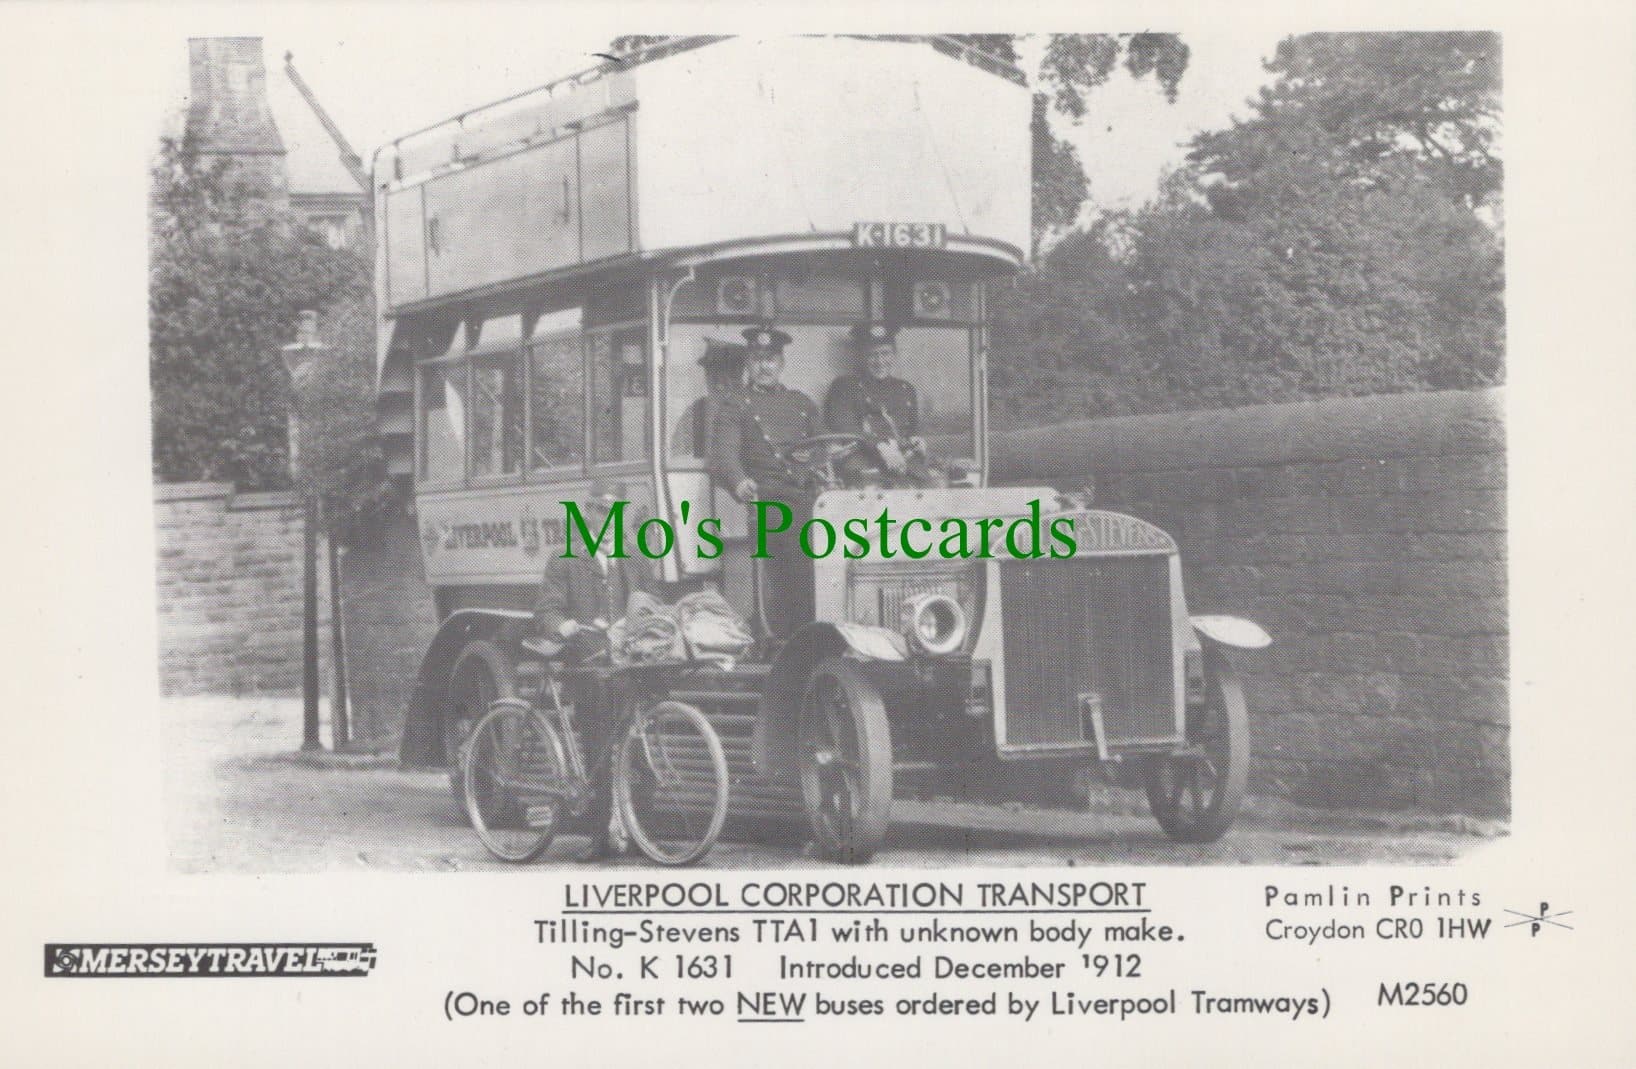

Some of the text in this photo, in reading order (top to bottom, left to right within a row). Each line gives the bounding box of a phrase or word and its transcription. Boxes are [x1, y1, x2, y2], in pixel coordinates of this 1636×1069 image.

[566, 882, 1146, 907] LIVERPOOL CORPORATION TRANSPORT
[1266, 886, 1480, 906] Pamlin Prints
[535, 917, 1184, 948] Tilling-Stevens TTA1 with unknown body make.
[1266, 919, 1364, 945] Croydon
[1438, 918, 1491, 939] 1HW
[79, 948, 324, 974] MERSEYTRAVEL
[572, 954, 1140, 979] No. K 1631 Introduced December 1912
[445, 988, 1331, 1019] (One of the first two NEW buses ordered by Liverpool Tramways)
[1379, 983, 1467, 1006] M2560
